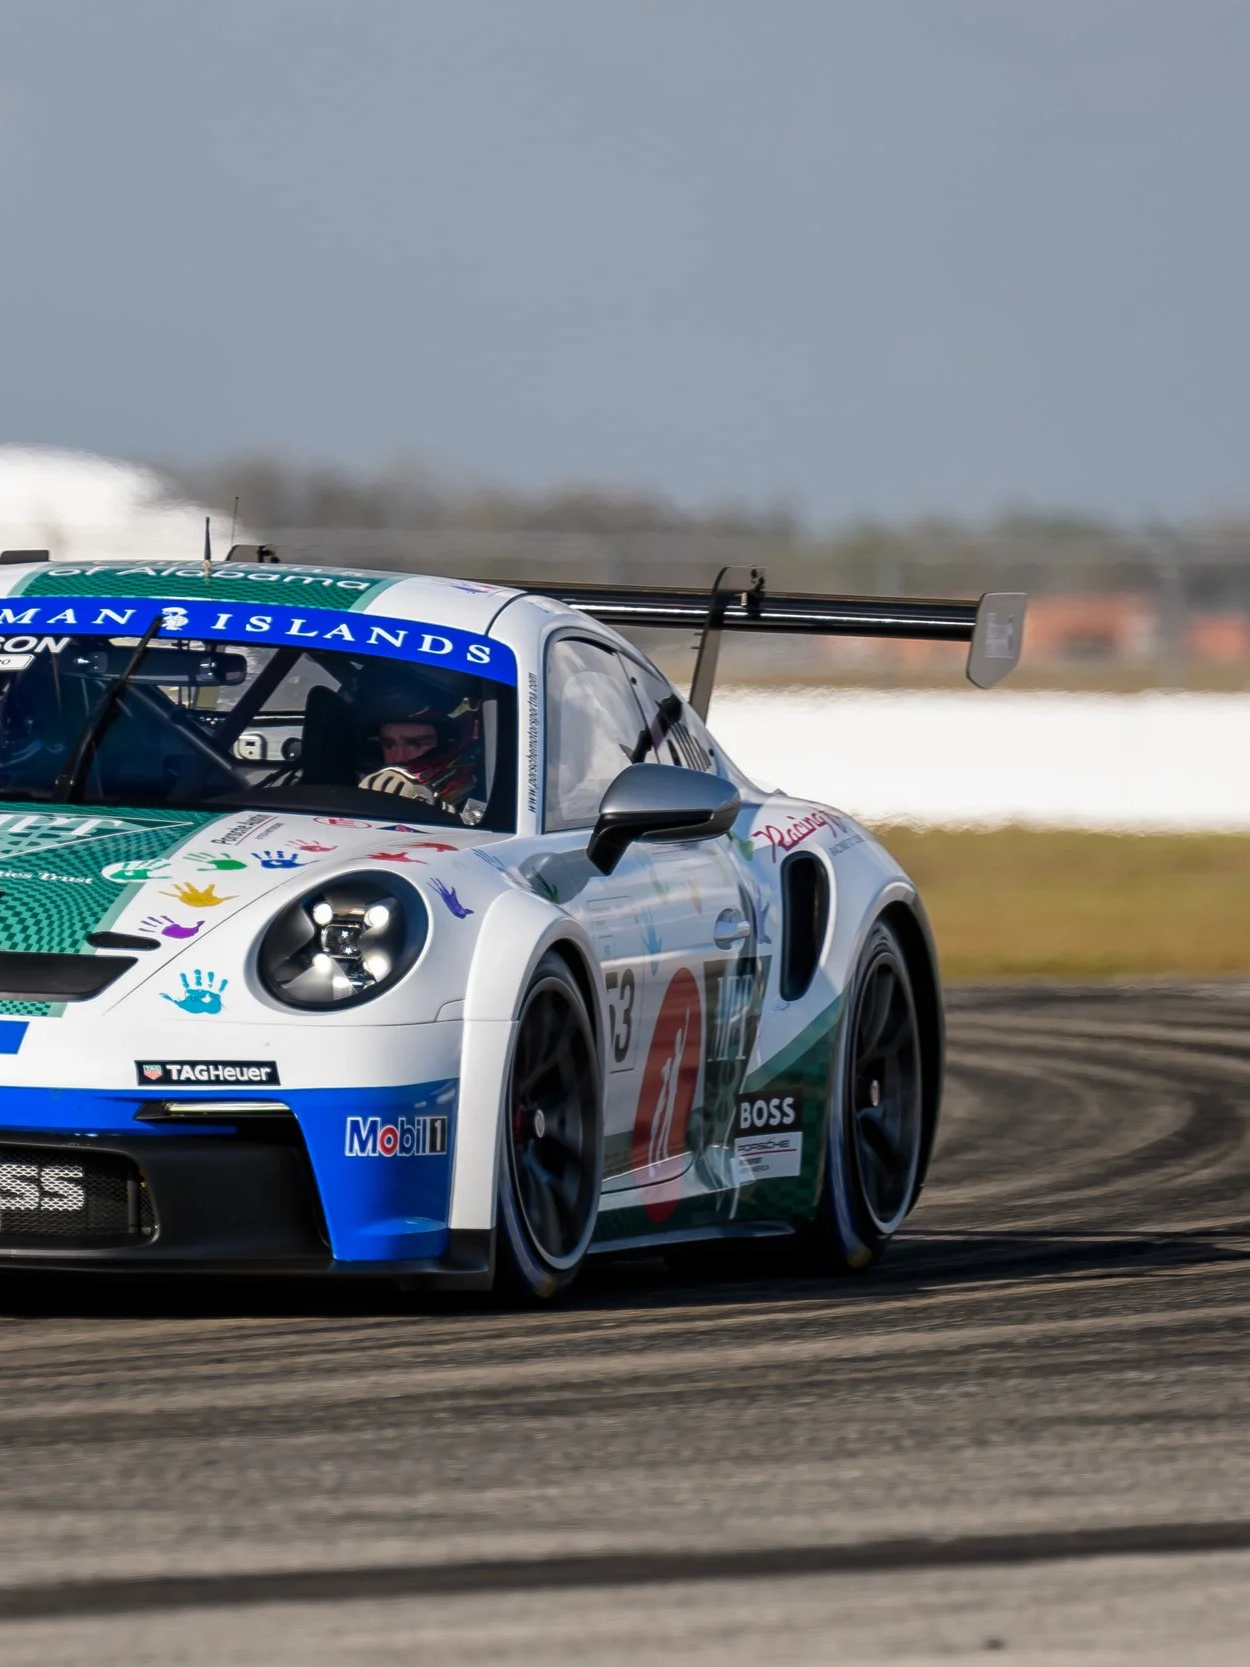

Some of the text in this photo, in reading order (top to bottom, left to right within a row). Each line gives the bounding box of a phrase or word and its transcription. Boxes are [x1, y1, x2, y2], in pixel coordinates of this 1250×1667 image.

[115, 566, 370, 590] Alabama
[211, 613, 491, 664] ISLANDS
[37, 871, 93, 885] Trust
[740, 1097, 795, 1129] BOSS
